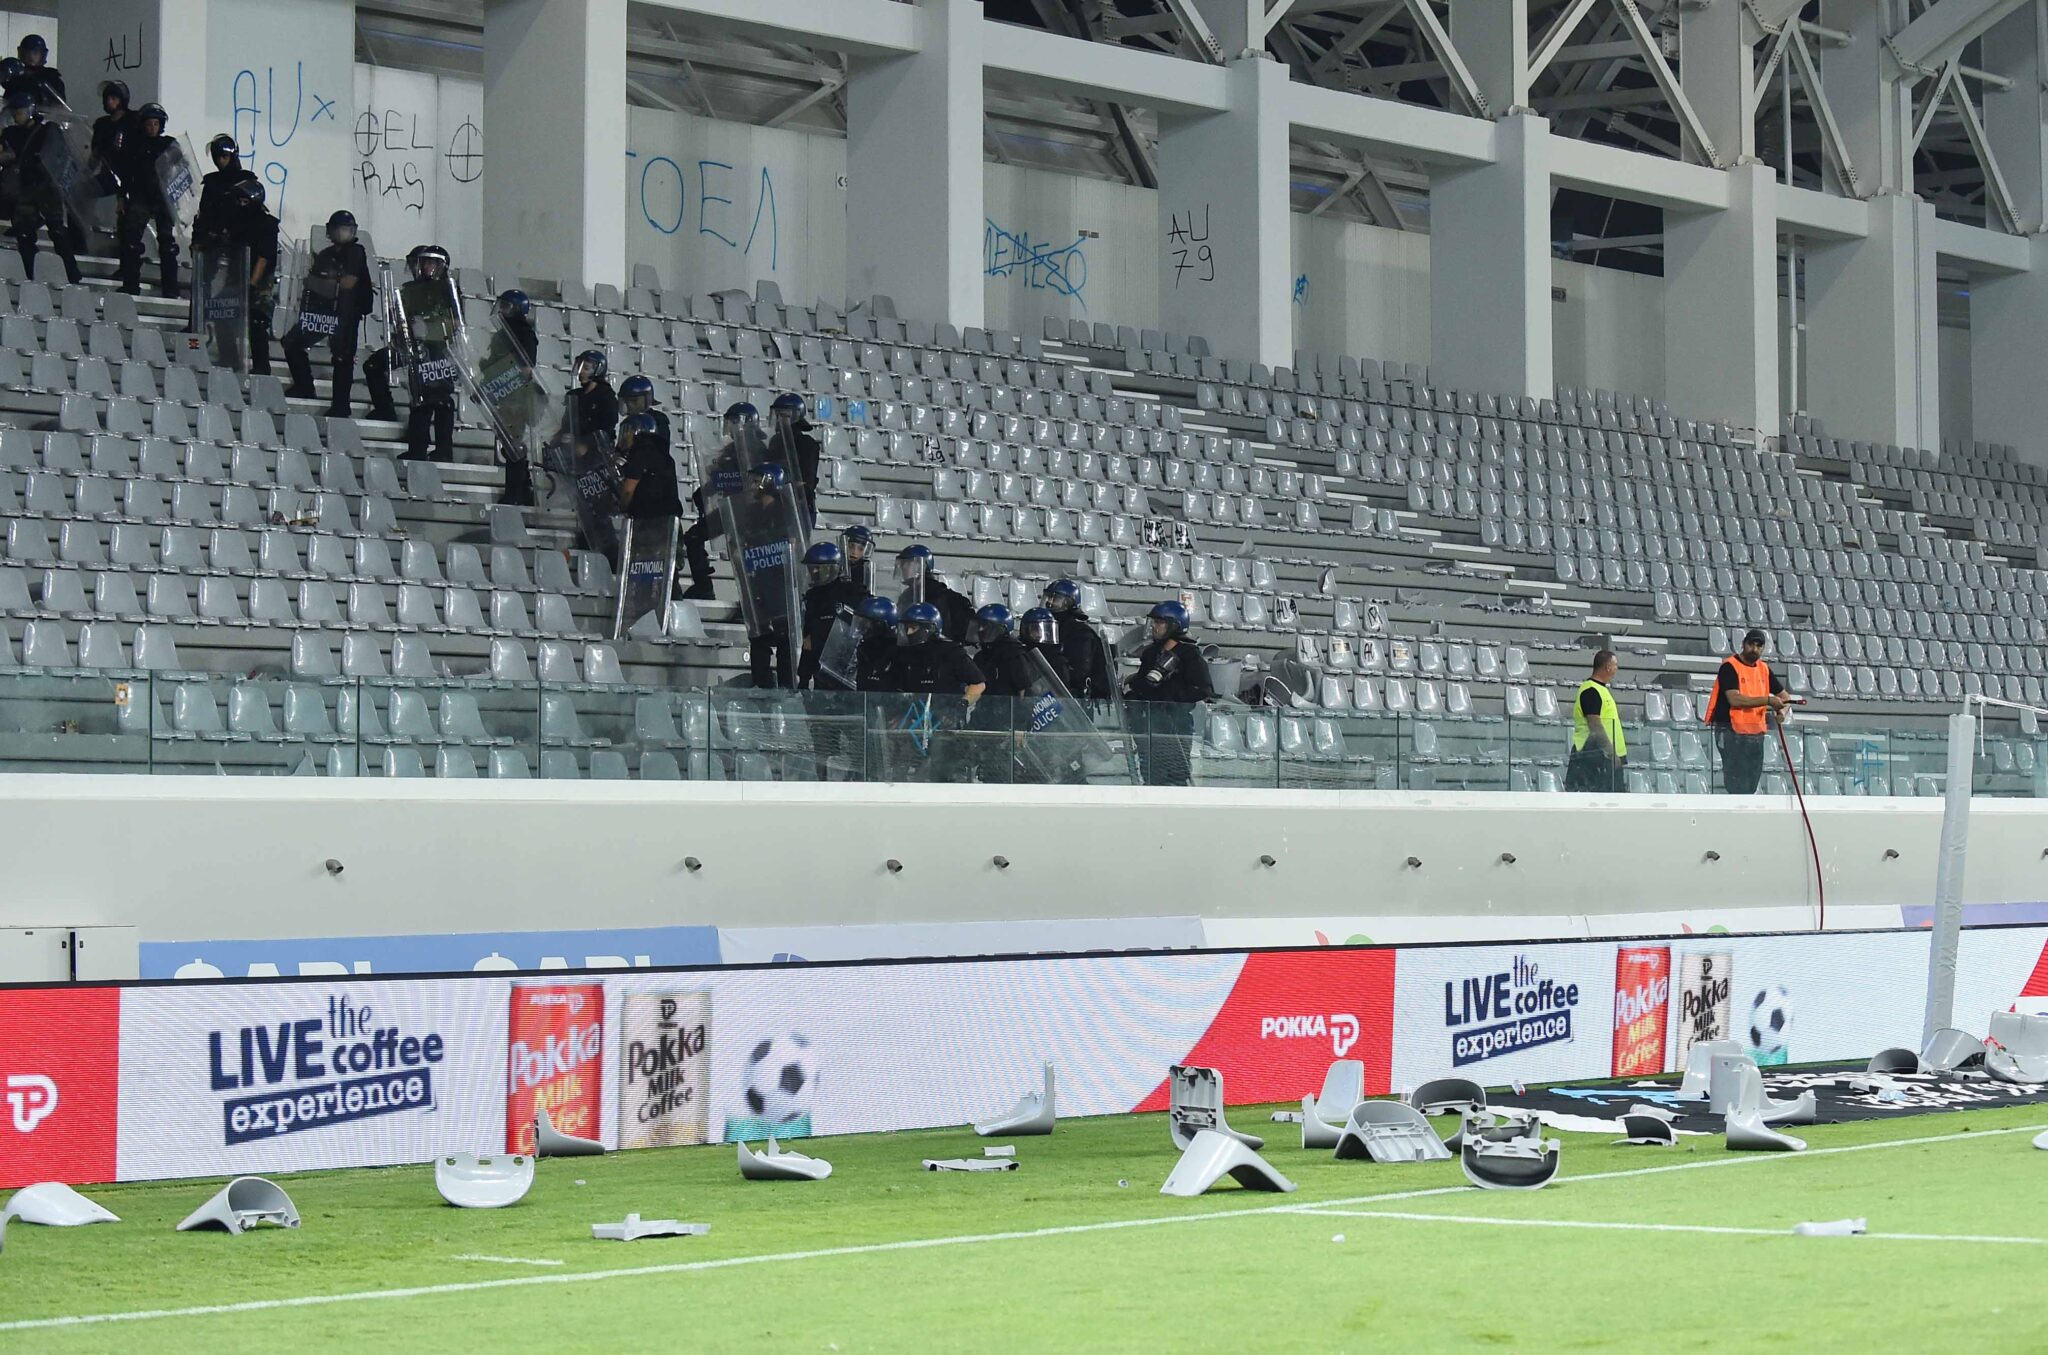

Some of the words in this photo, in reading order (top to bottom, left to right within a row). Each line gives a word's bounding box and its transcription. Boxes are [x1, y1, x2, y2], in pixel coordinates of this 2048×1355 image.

[1173, 246, 1214, 288] 79
[301, 321, 335, 335] POLICE
[422, 367, 457, 382] POLICE
[1513, 955, 1539, 987] the
[328, 994, 372, 1019] the
[1445, 972, 1511, 1027] LIVE
[1515, 979, 1579, 1014] coffee
[1682, 977, 1728, 1023] Pokka
[1261, 1014, 1328, 1040] POKKA
[1456, 1016, 1567, 1059] experience
[209, 1019, 326, 1091] LIVE
[331, 1027, 443, 1074] coffee
[628, 1024, 705, 1085] Pokka
[231, 1076, 424, 1133] experience
[637, 1087, 693, 1123] Coffee
